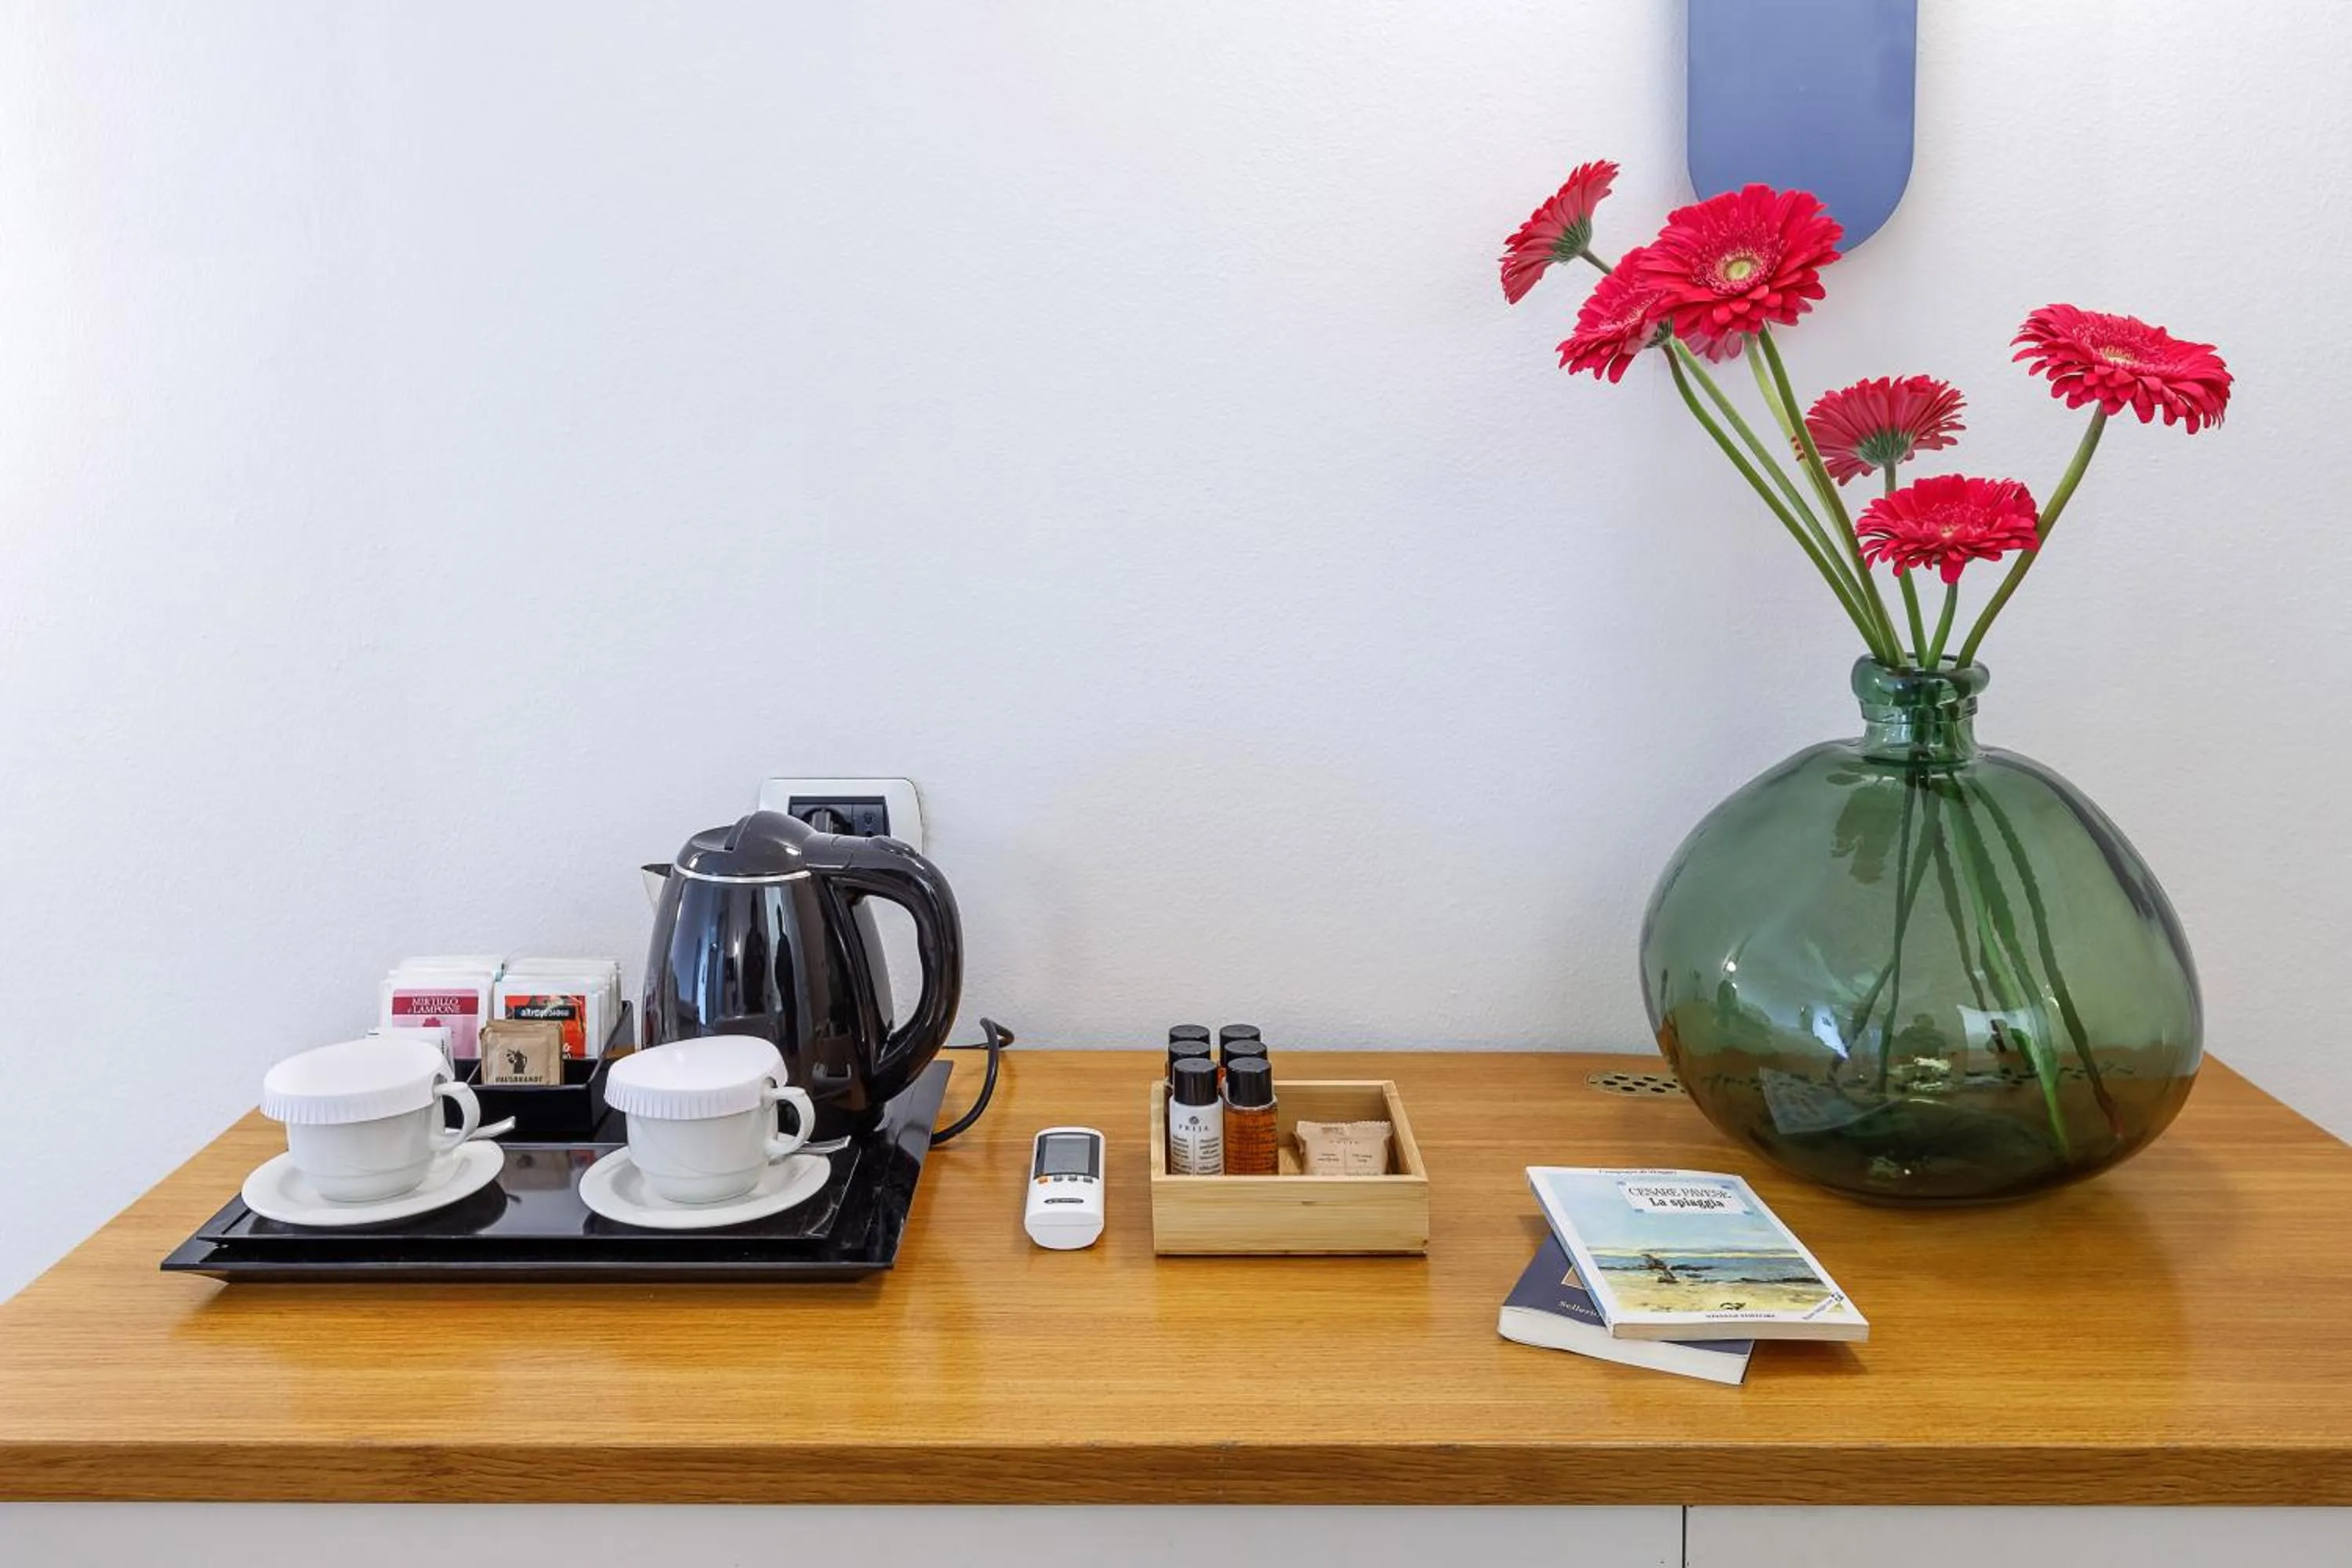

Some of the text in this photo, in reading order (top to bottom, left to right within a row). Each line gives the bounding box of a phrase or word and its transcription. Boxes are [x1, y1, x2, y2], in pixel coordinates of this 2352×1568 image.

[412, 996, 459, 1006] MIRTILLO
[412, 1005, 462, 1014] LAMPONE
[1628, 1187, 1732, 1199] CESARE PAVESE
[1650, 1197, 1725, 1210] La spiaggia
